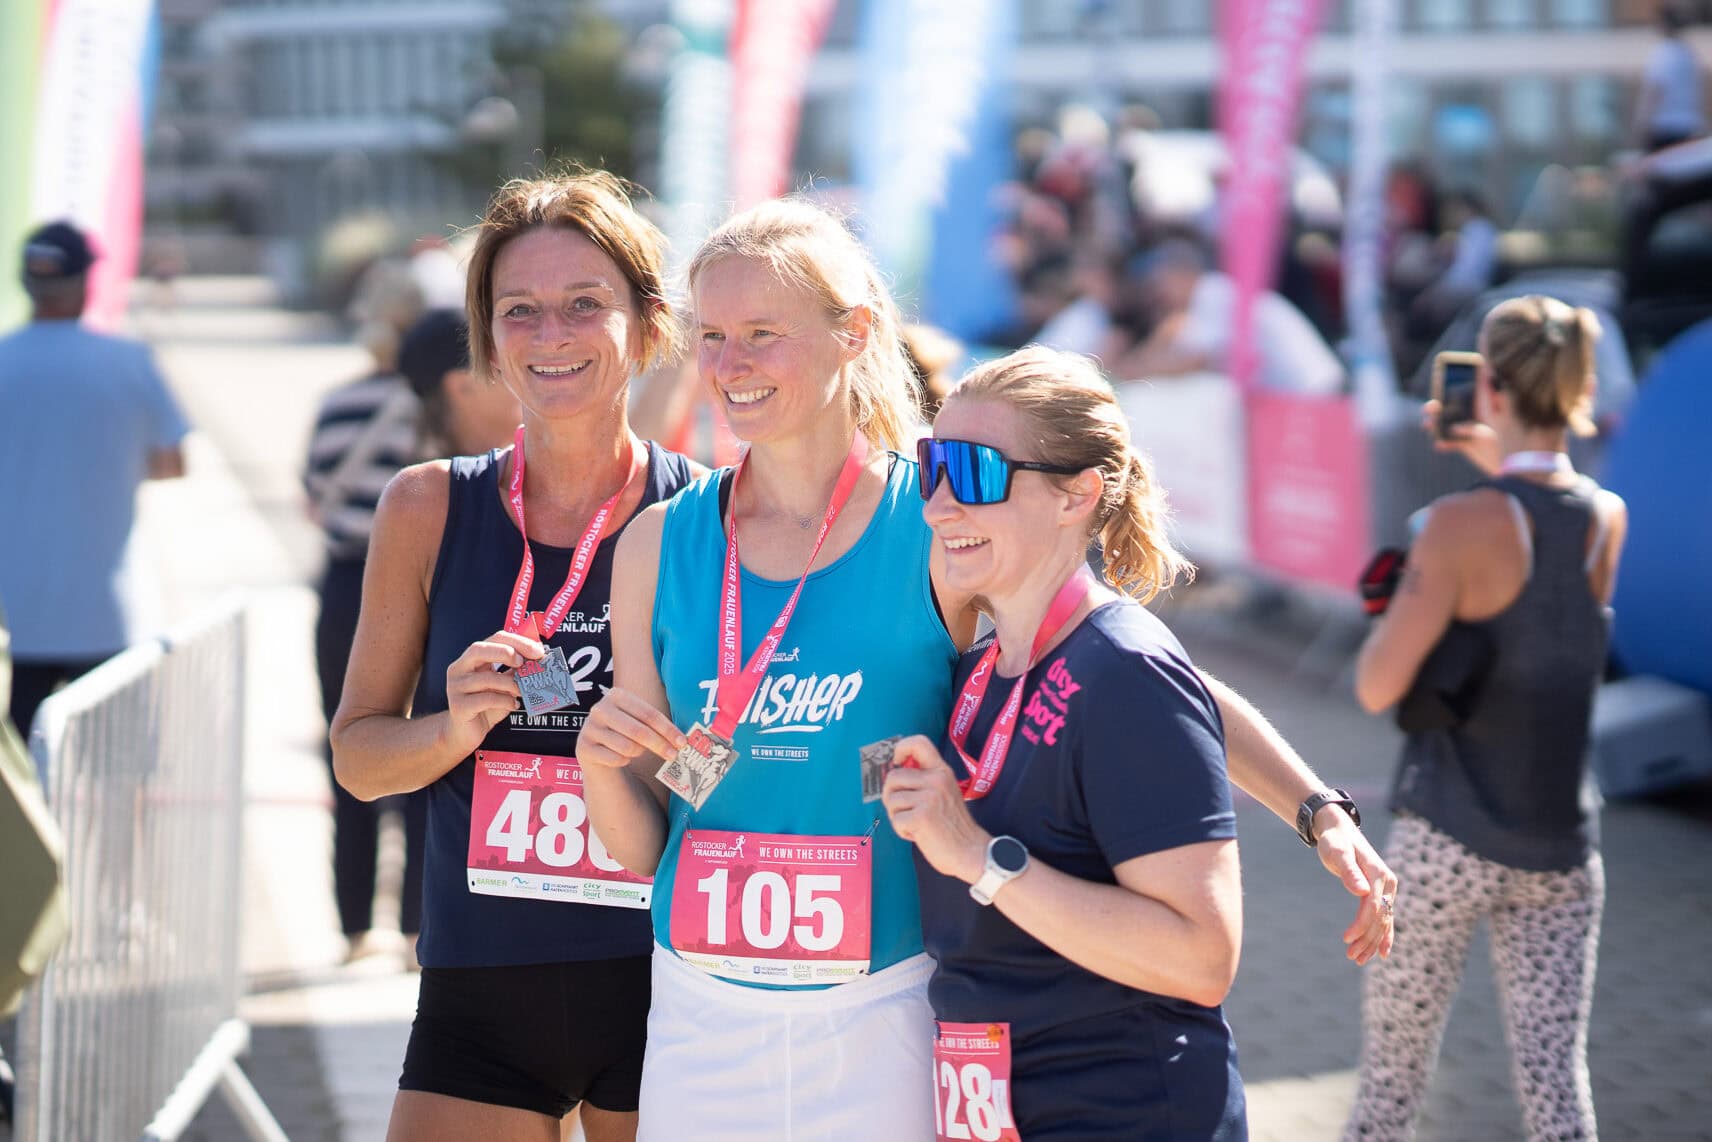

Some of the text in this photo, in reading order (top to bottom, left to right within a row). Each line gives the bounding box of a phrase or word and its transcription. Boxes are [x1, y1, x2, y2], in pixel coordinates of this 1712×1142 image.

[575, 509, 608, 570] ROSTOCKER
[724, 583, 737, 650] FRAUENLAUF
[556, 622, 606, 633] ENLAUF
[723, 651, 735, 675] 2025
[511, 714, 524, 725] WE
[527, 715, 548, 726] OWN
[552, 715, 569, 727] THE
[484, 761, 522, 771] ROSTOCKER
[488, 769, 535, 779] FRAUENLAUF
[556, 768, 569, 780] WE
[691, 841, 727, 850] ROSTOCKER
[693, 849, 738, 858] FRAUENLAUF
[759, 847, 858, 860] WE OWN THE STREETS
[697, 868, 845, 952] 105
